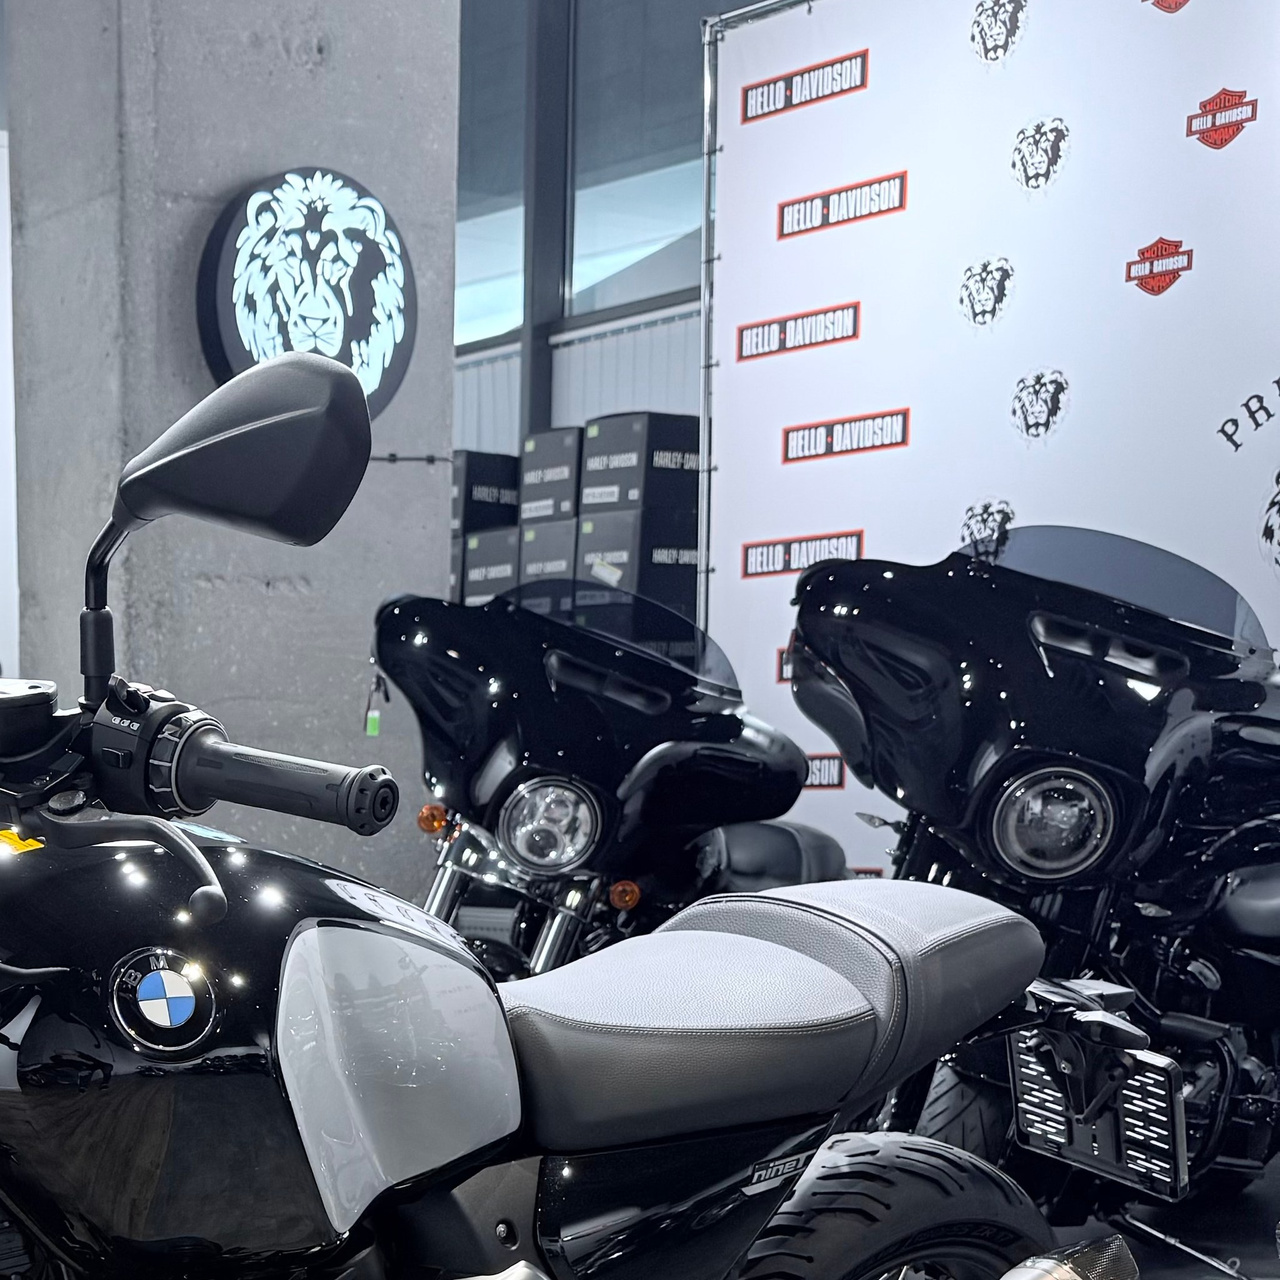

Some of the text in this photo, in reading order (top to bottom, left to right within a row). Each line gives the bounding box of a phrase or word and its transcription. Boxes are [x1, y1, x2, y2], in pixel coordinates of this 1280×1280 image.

[747, 56, 862, 118] HELLO DAVIDSON
[783, 177, 901, 235] HELLO DAVIDSON
[742, 307, 854, 358] HELLO DAVIDSON
[787, 413, 904, 460] HELLO DAVIDSON
[747, 543, 785, 575] HELLO
